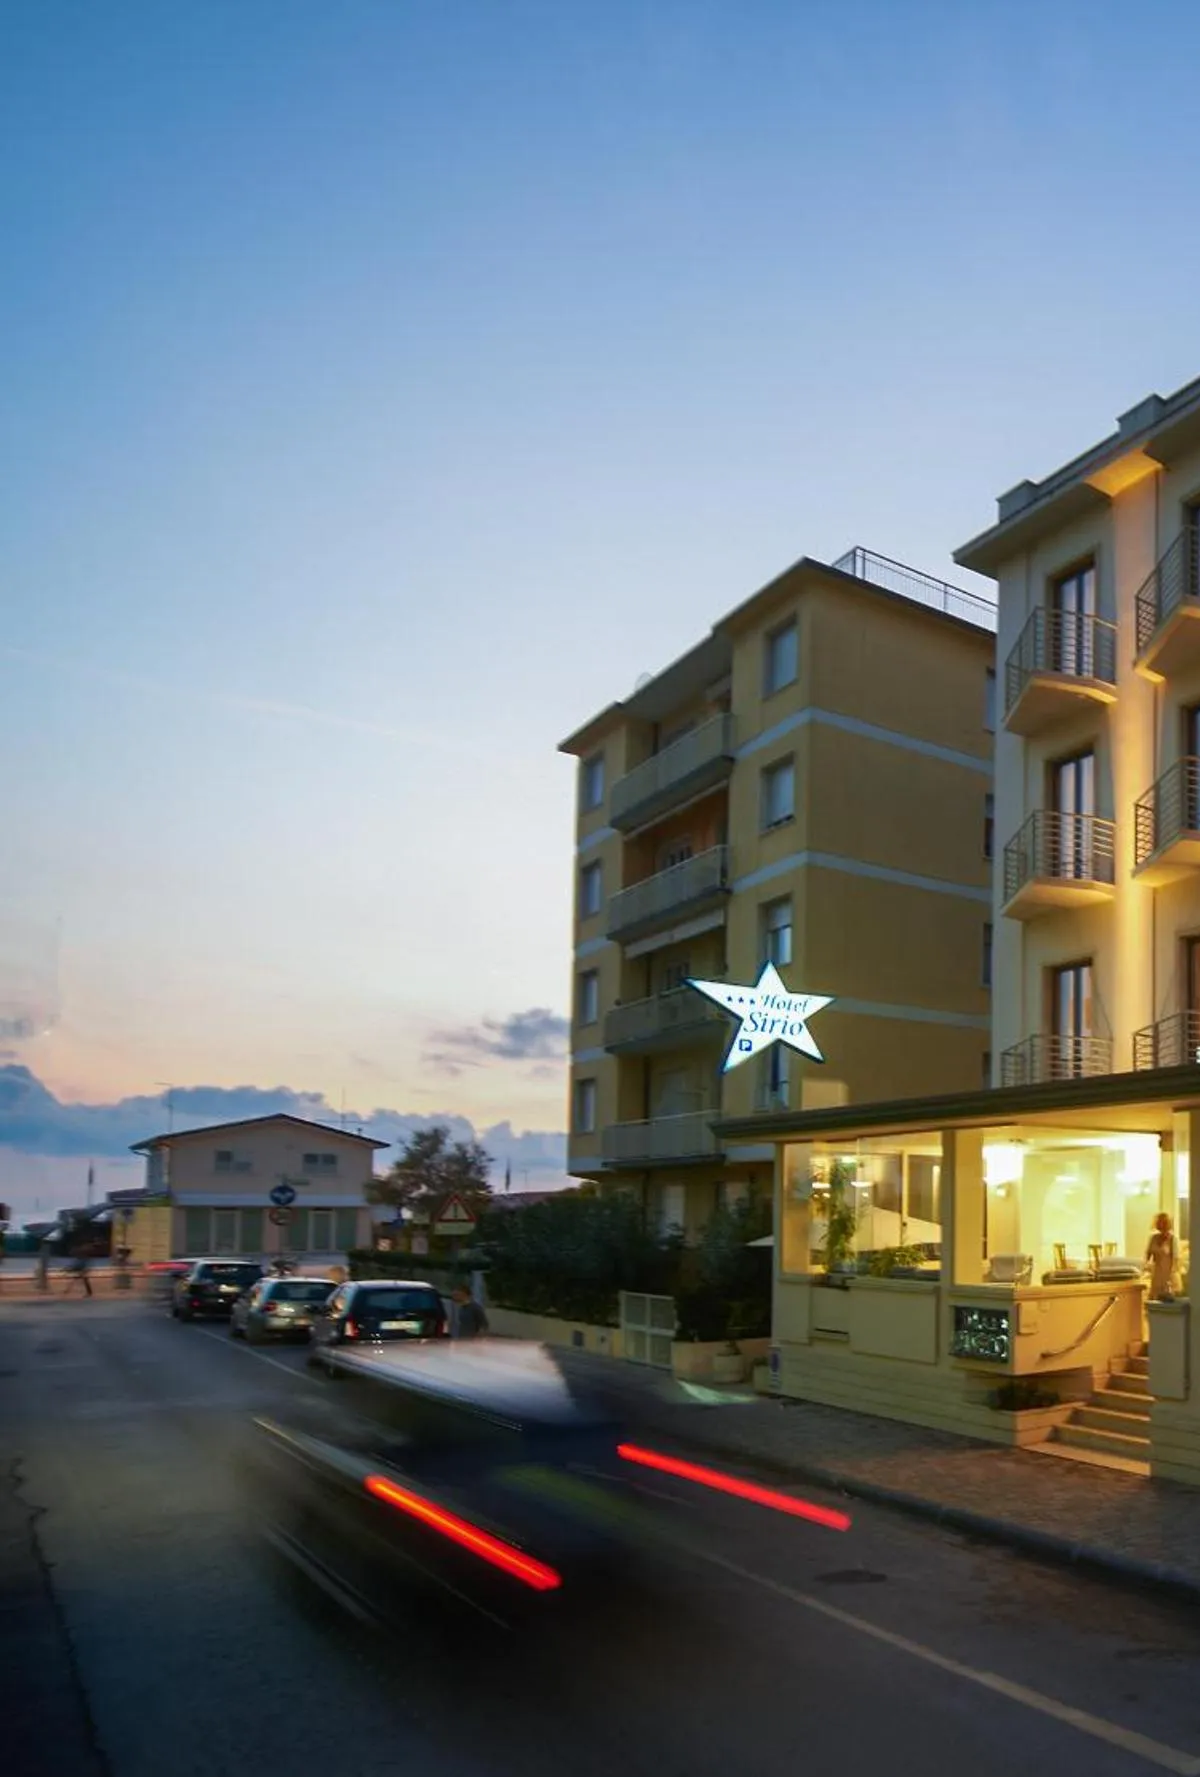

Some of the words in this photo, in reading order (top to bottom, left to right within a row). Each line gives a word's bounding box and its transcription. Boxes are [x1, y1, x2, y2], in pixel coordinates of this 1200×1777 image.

[761, 994, 809, 1012] Hotel
[744, 1011, 803, 1036] Sirio
[741, 1041, 751, 1051] P
